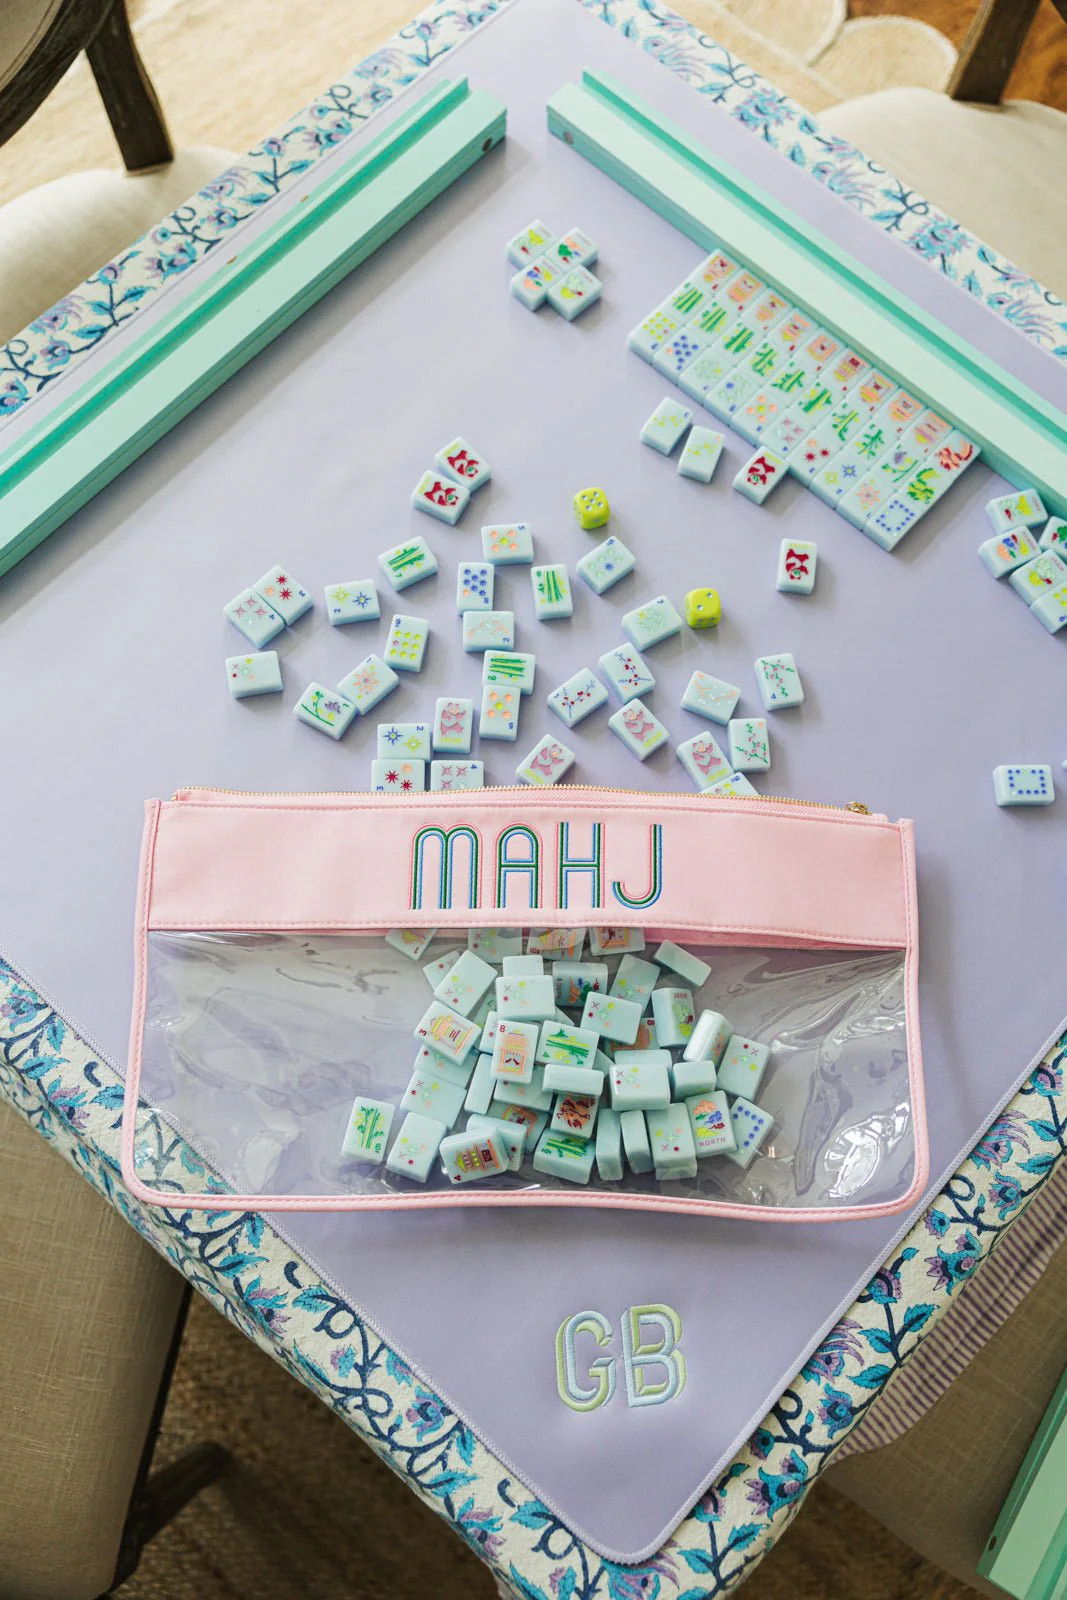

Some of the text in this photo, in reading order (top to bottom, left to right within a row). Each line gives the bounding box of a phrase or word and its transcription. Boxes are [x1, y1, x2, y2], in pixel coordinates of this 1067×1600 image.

[408, 822, 662, 910] MAHJ
[418, 1028, 428, 1037] 3
[499, 1024, 506, 1033] 8
[698, 1136, 727, 1149] NORTH
[555, 1303, 688, 1413] GB
